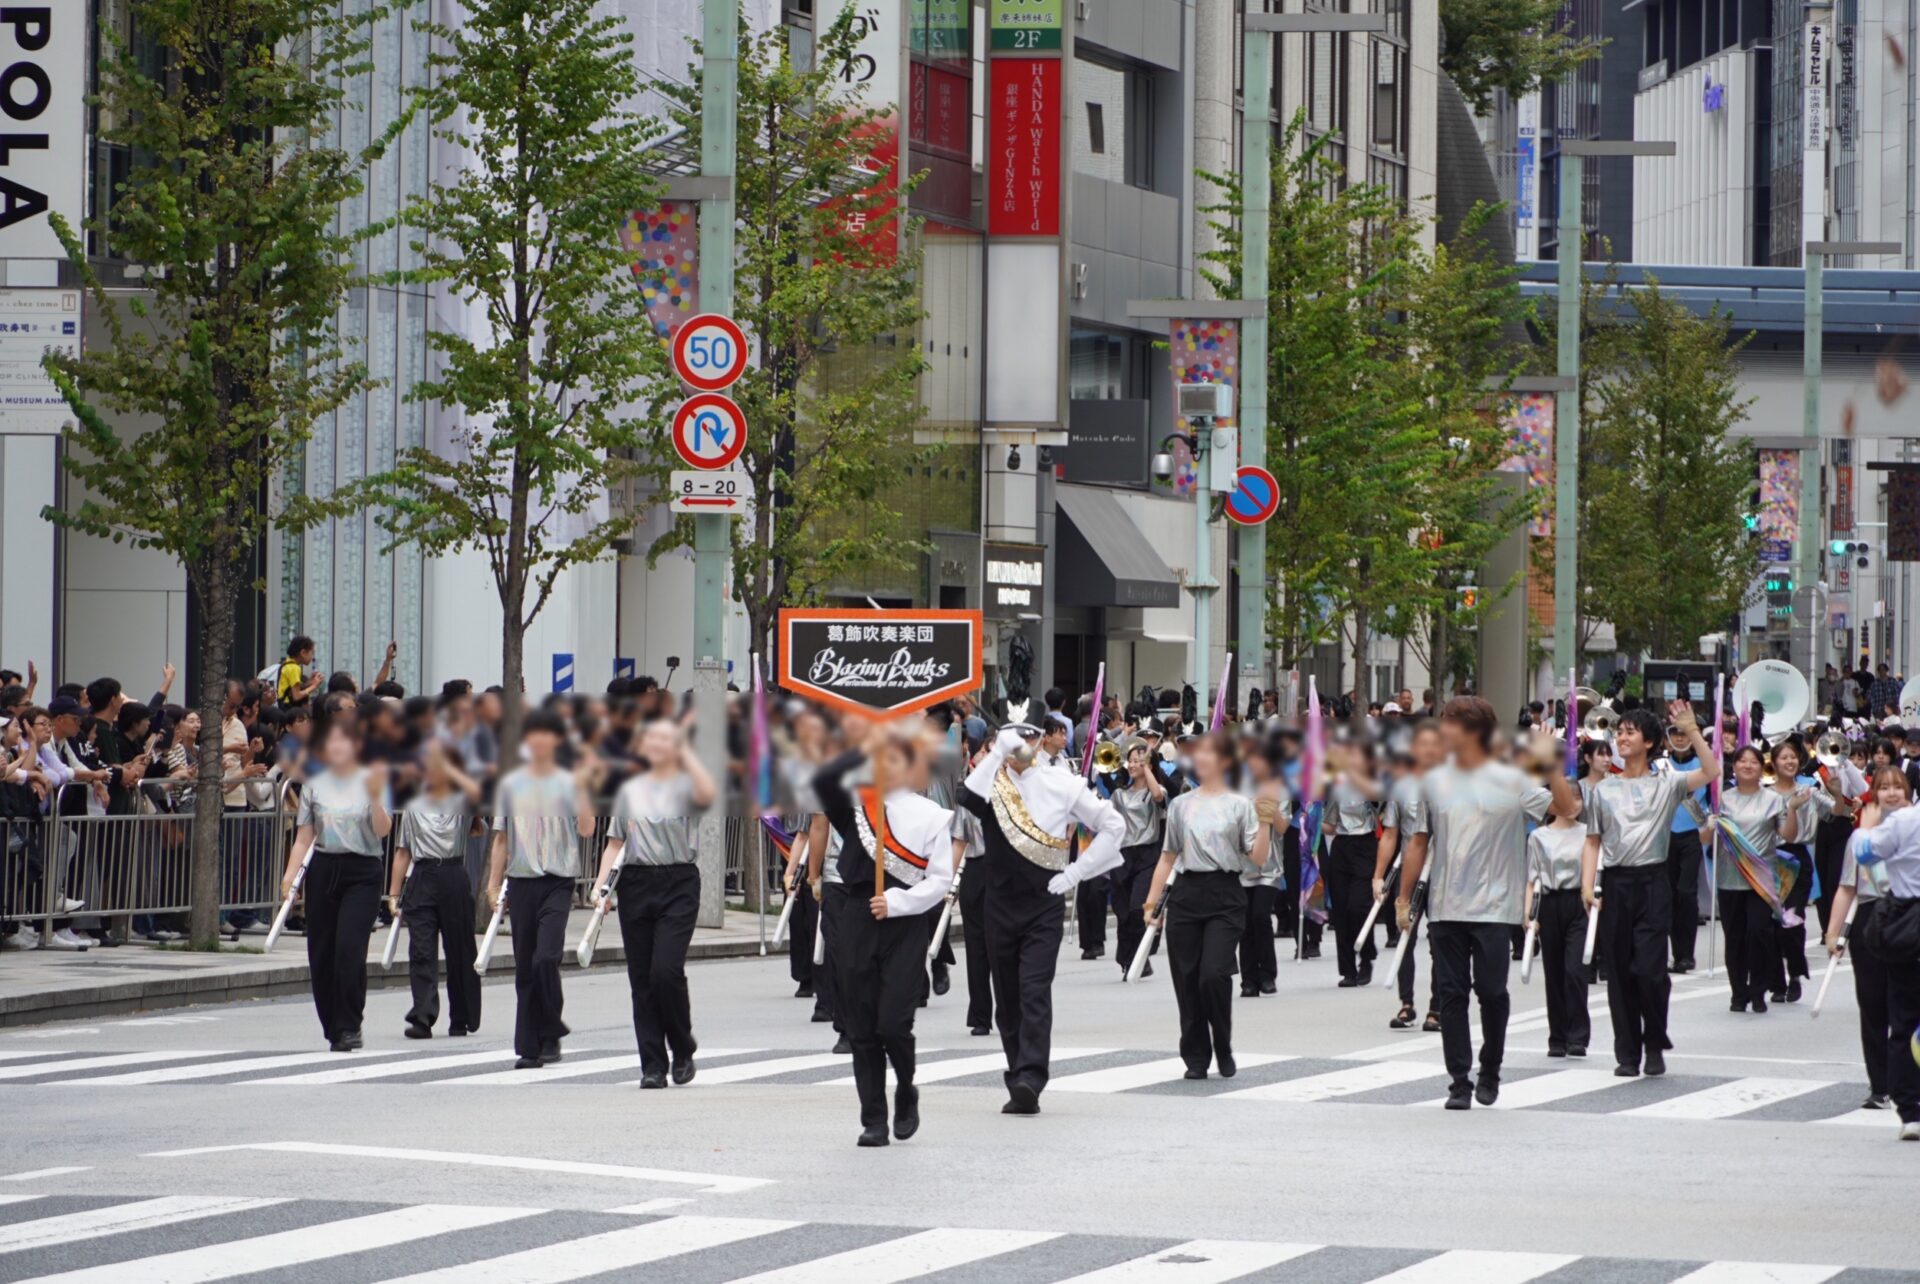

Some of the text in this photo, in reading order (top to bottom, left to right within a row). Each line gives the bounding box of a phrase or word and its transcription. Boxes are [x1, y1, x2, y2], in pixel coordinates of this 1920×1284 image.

[1014, 30, 1041, 48] 2F
[1810, 26, 1821, 85] キムラヤビル
[0, 7, 51, 229] POLA
[1030, 64, 1043, 231] HANDA Watch World
[627, 236, 687, 255] UTUMN
[690, 337, 731, 369] 50
[828, 625, 934, 643] 葛飾吹奏楽団
[809, 647, 889, 687] Blazing
